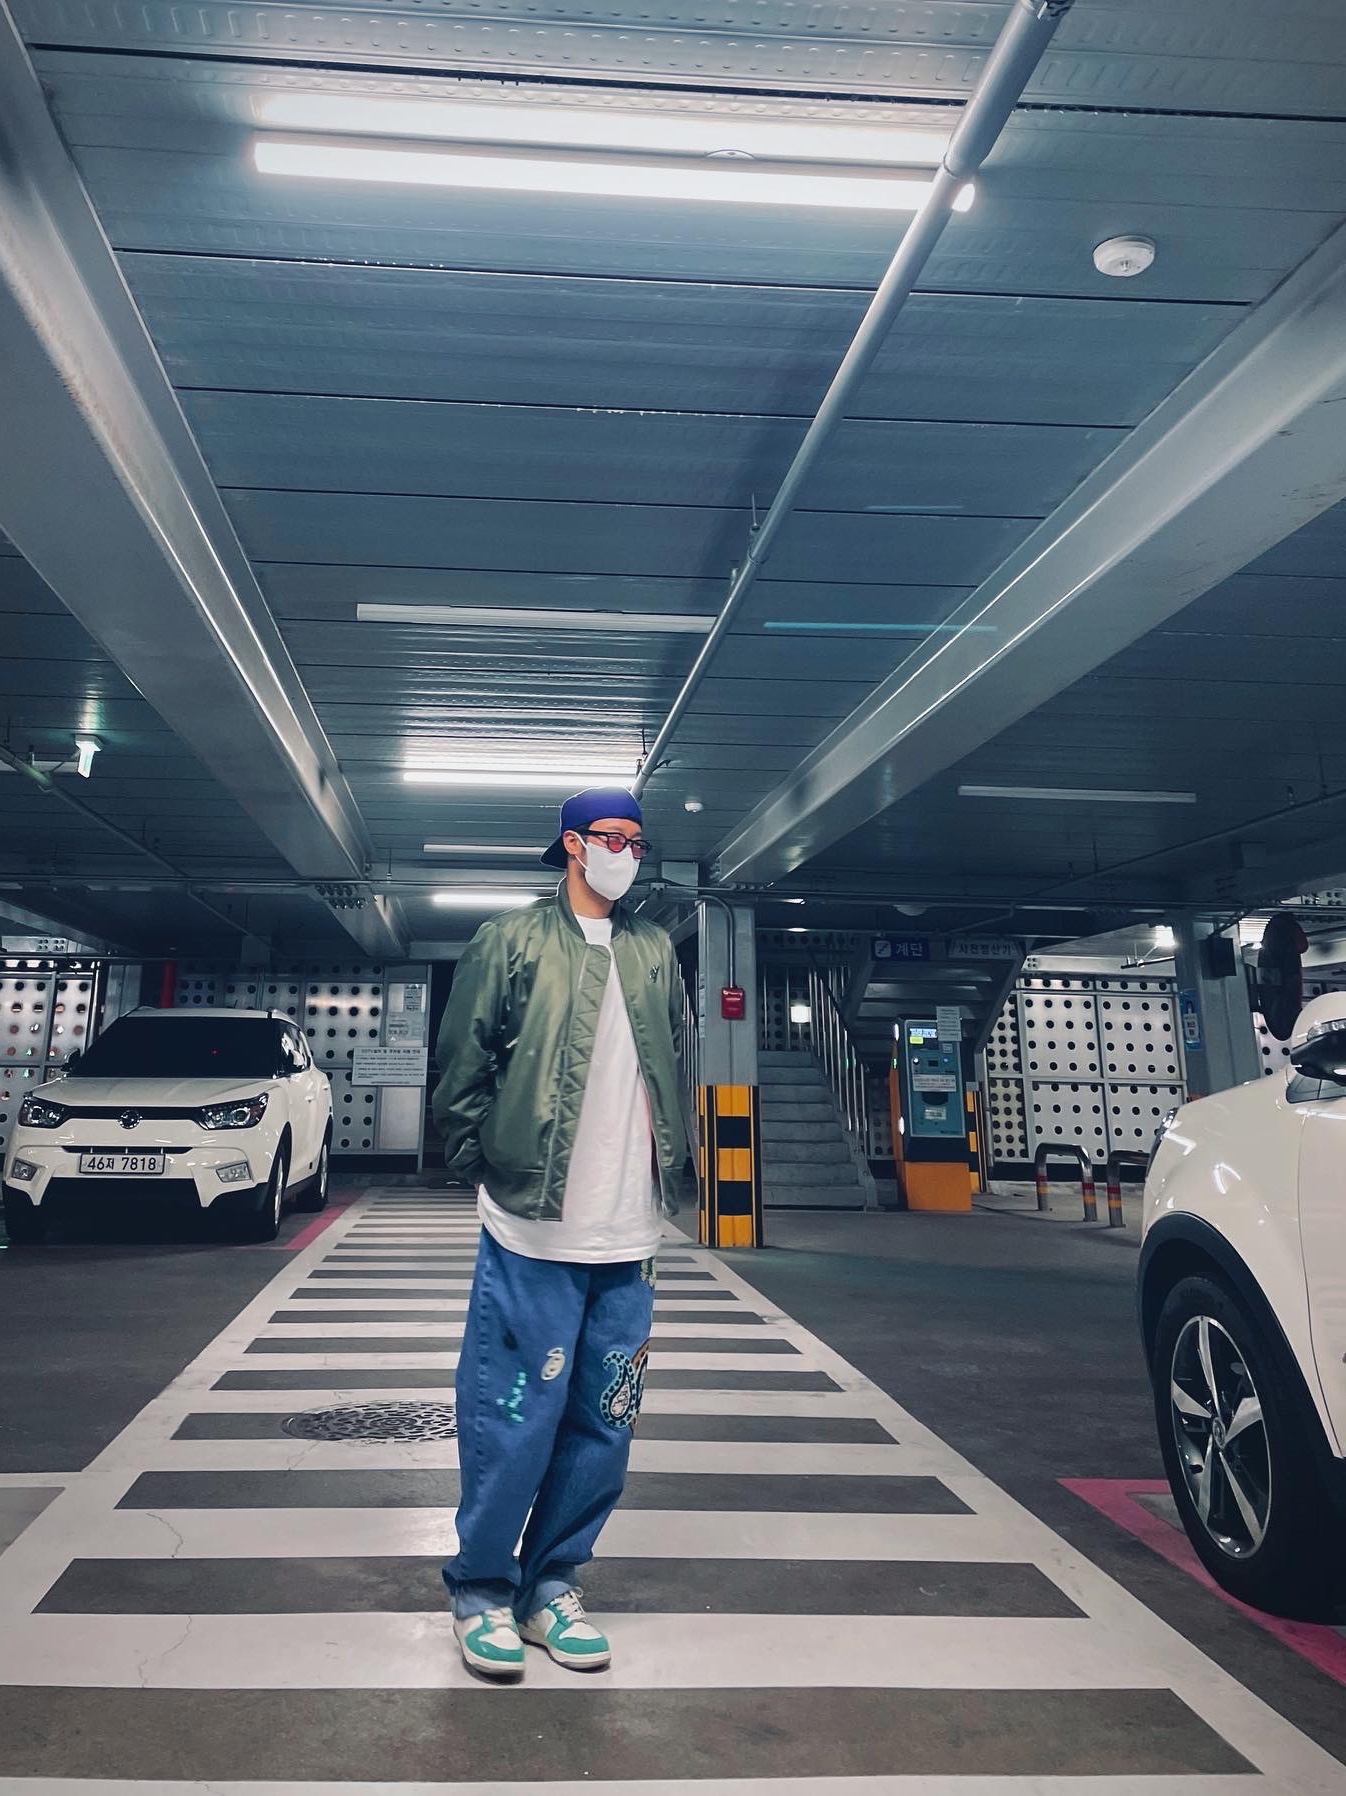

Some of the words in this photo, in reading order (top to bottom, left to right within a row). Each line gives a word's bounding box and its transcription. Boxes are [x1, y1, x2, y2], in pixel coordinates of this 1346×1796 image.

[895, 943, 923, 957] 계단
[958, 943, 1011, 956] 사전정산기
[87, 1157, 115, 1171] 46저
[121, 1157, 157, 1171] 7818
